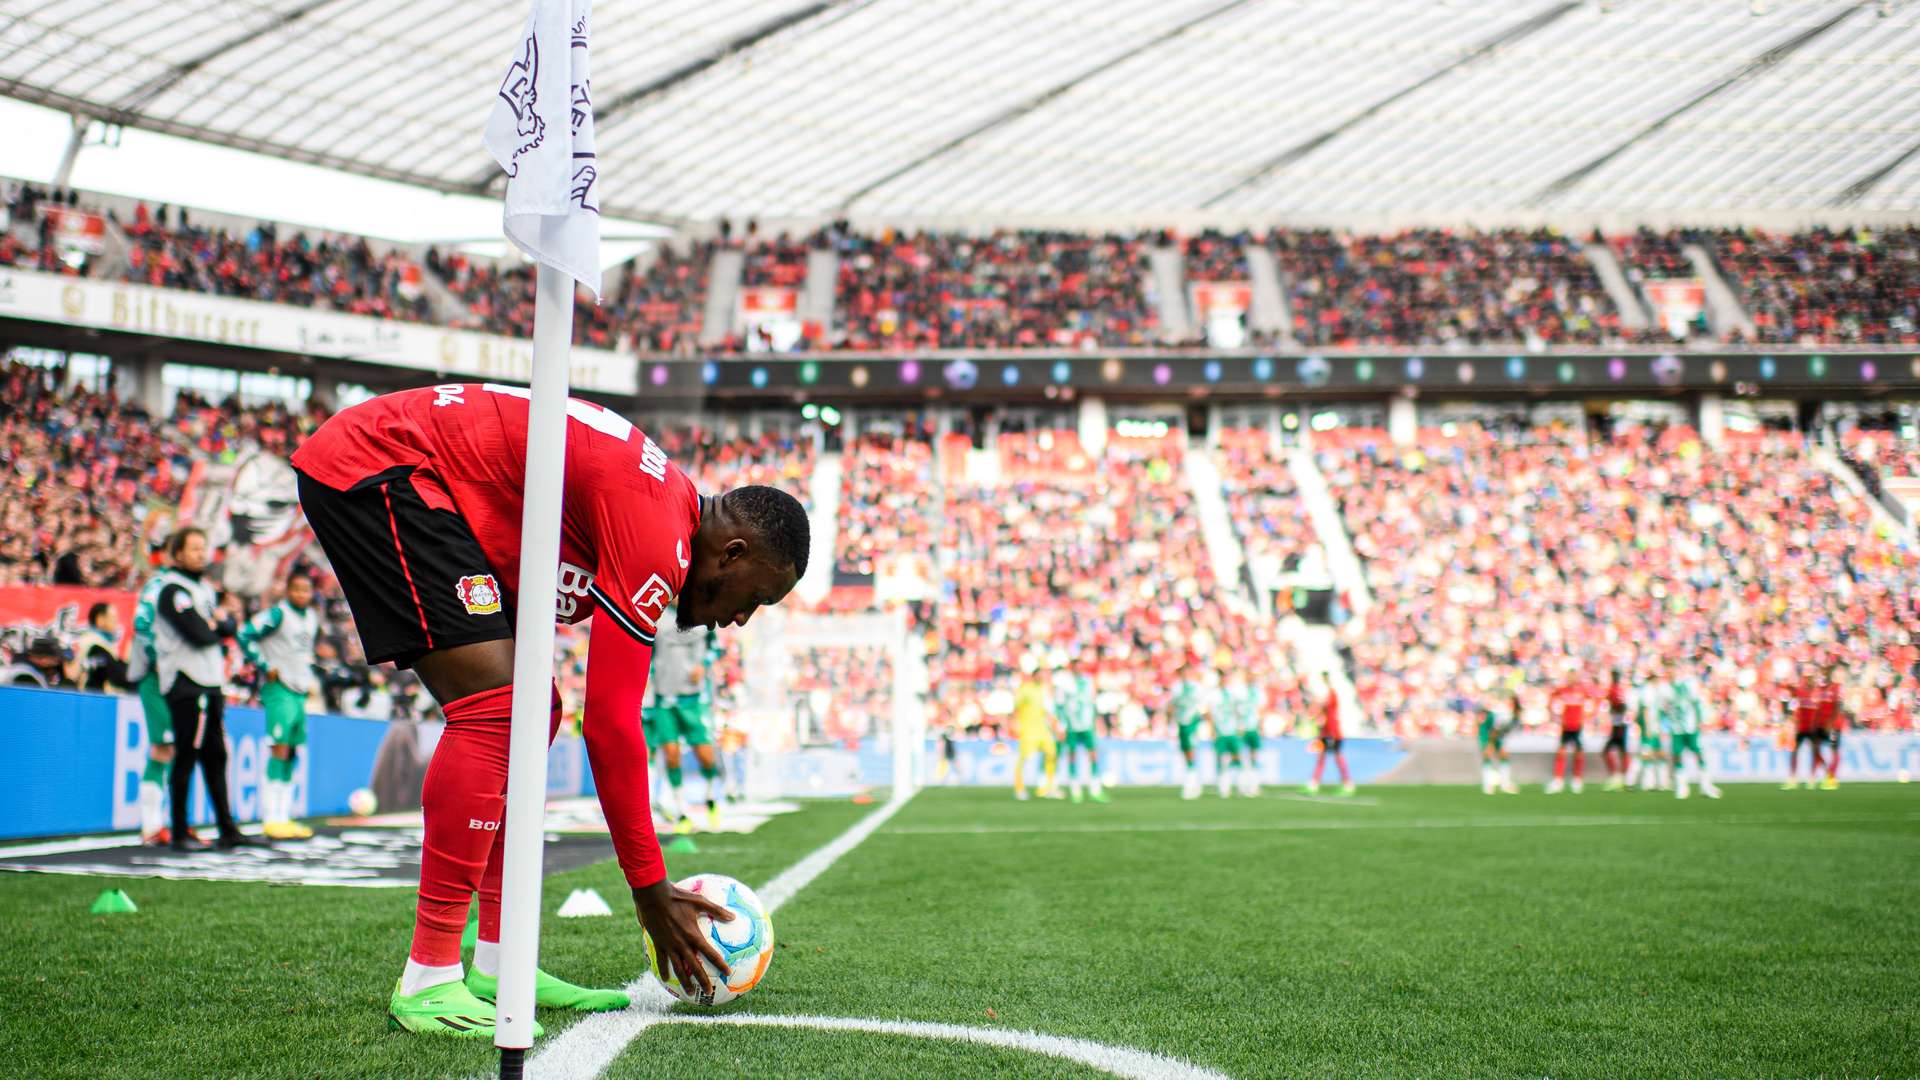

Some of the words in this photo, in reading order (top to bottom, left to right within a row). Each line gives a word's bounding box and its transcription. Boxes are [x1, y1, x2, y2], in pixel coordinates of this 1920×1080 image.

[112, 288, 262, 344] Bitburger
[433, 383, 465, 407] 04
[556, 562, 596, 624] Ba
